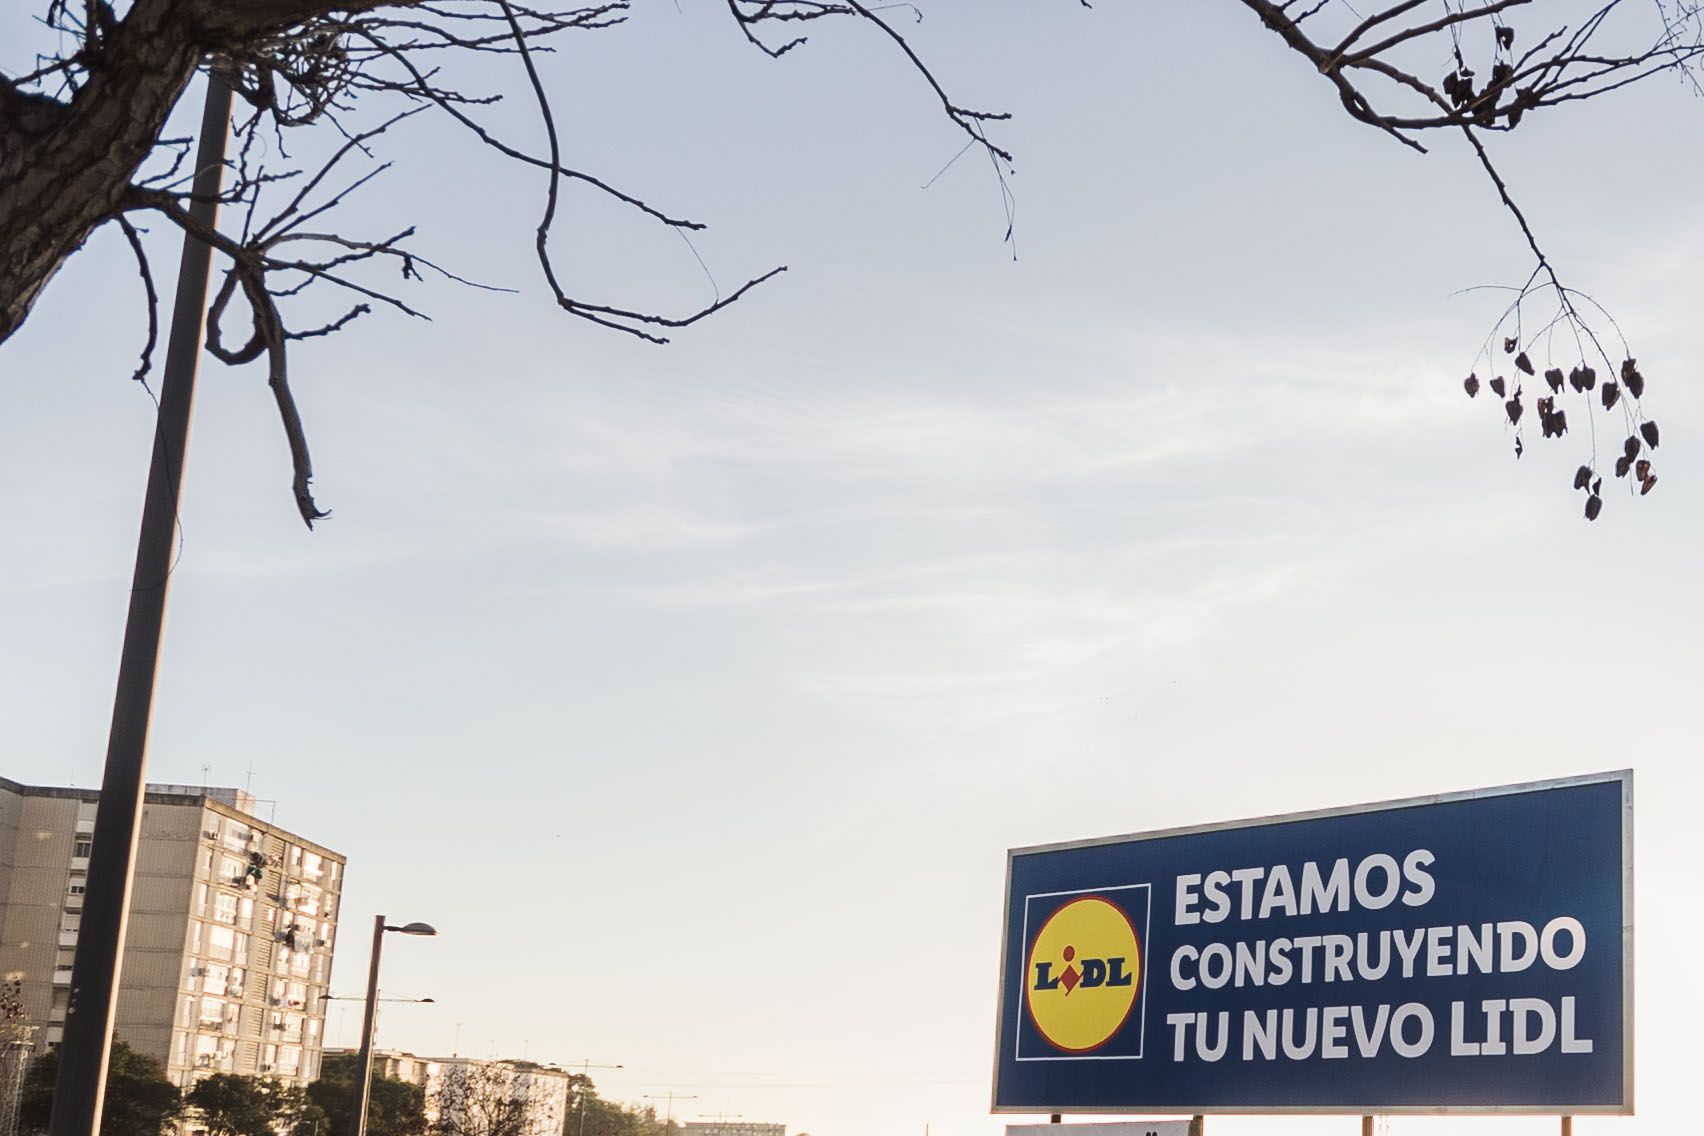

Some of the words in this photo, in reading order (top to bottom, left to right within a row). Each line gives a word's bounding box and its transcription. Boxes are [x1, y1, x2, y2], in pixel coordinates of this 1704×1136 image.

[1174, 848, 1437, 926] ESTAMOS
[1170, 916, 1587, 991] CONSTRUYENDO
[1166, 1010, 1230, 1062] TU
[1242, 1002, 1436, 1061] NUEVO
[1450, 995, 1594, 1057] LIDL
